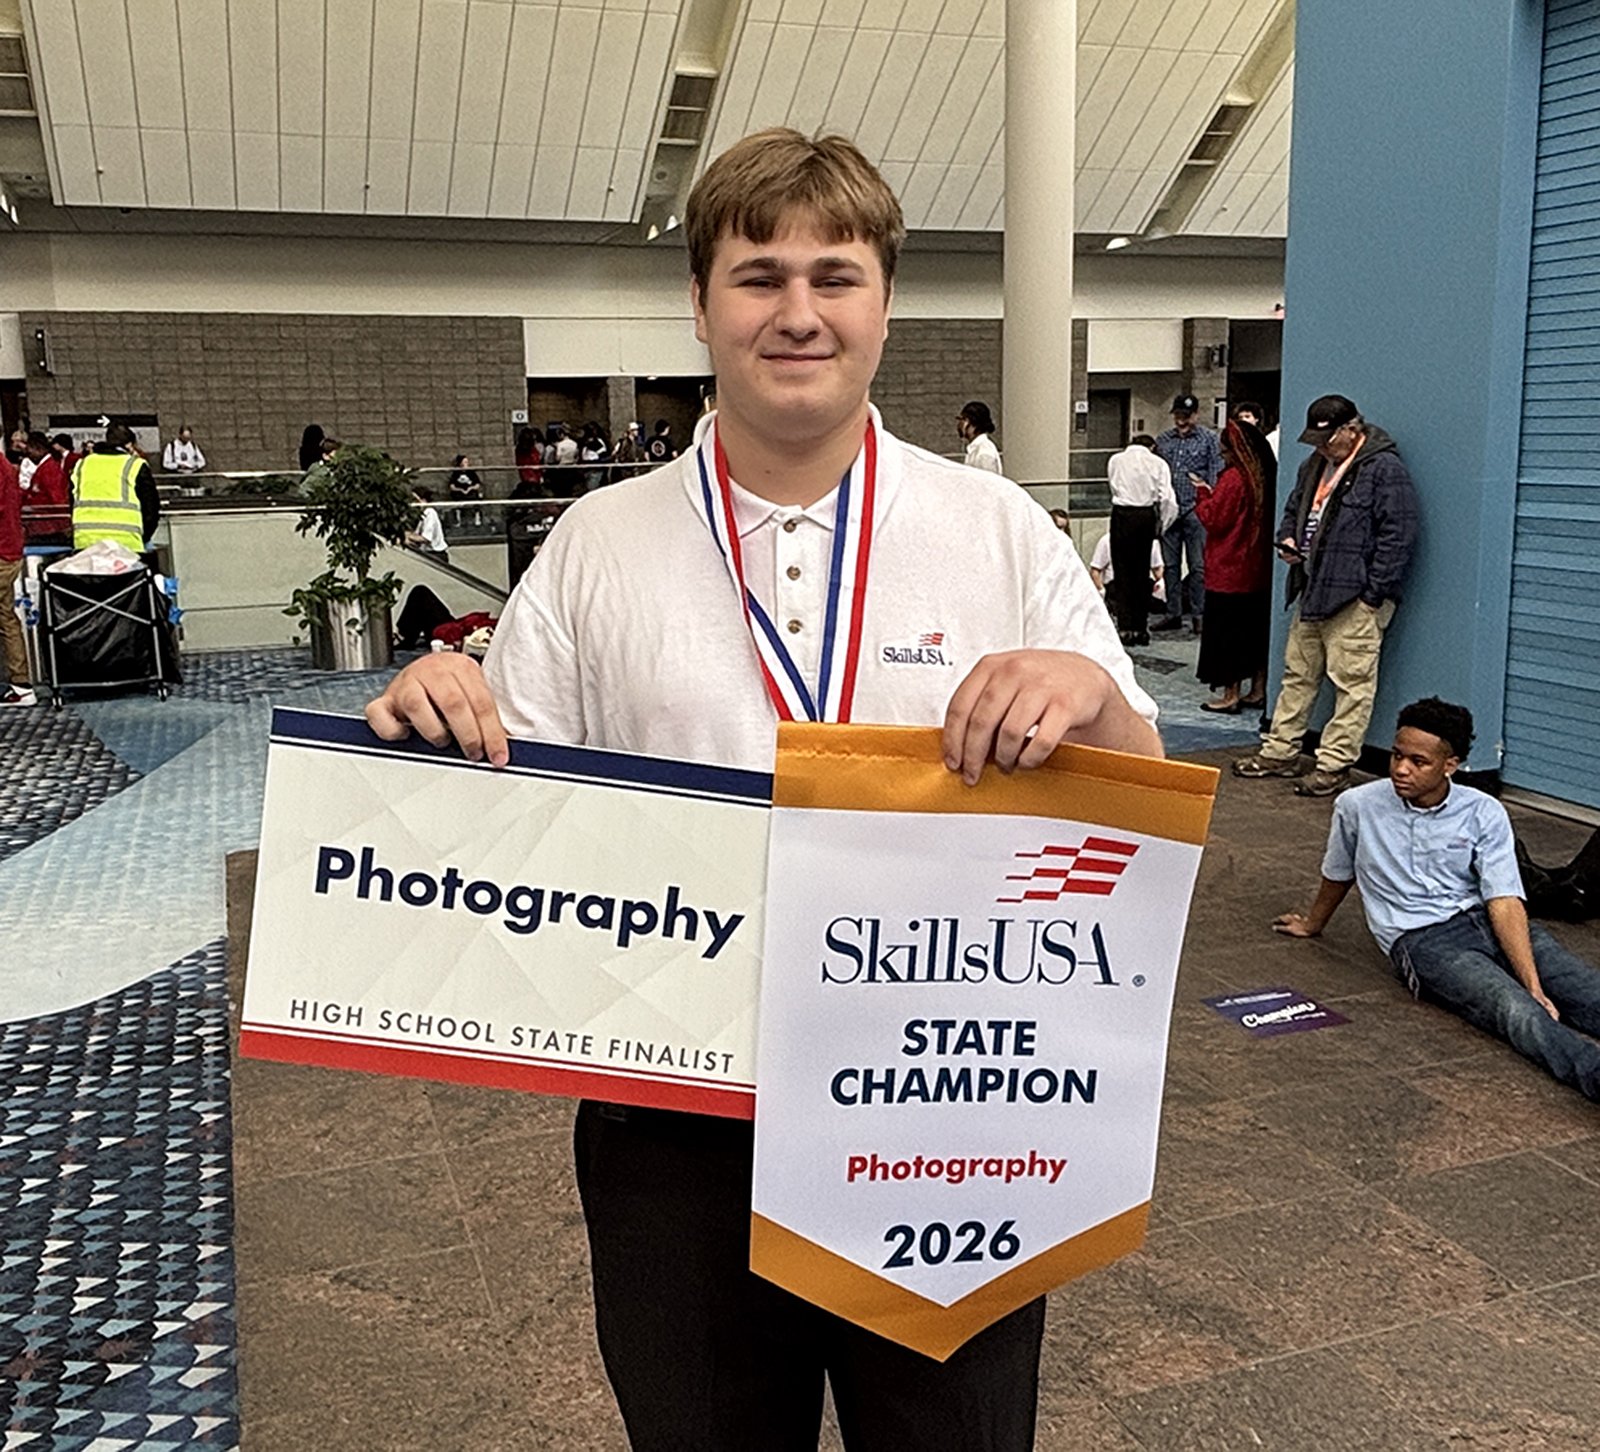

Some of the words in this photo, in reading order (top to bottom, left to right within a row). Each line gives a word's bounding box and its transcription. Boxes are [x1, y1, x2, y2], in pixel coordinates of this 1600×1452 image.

[314, 845, 745, 960] Photography
[821, 916, 1120, 986] SkillsUSA
[290, 999, 363, 1027] HIGH
[378, 1010, 495, 1043] SCHOOL
[510, 1026, 593, 1056] STATE
[608, 1039, 734, 1074] FINALIST
[901, 1019, 1037, 1057] STATE
[830, 1067, 1098, 1106] CHAMPION
[847, 1152, 1067, 1184] Photography
[881, 1219, 1021, 1270] 2026
